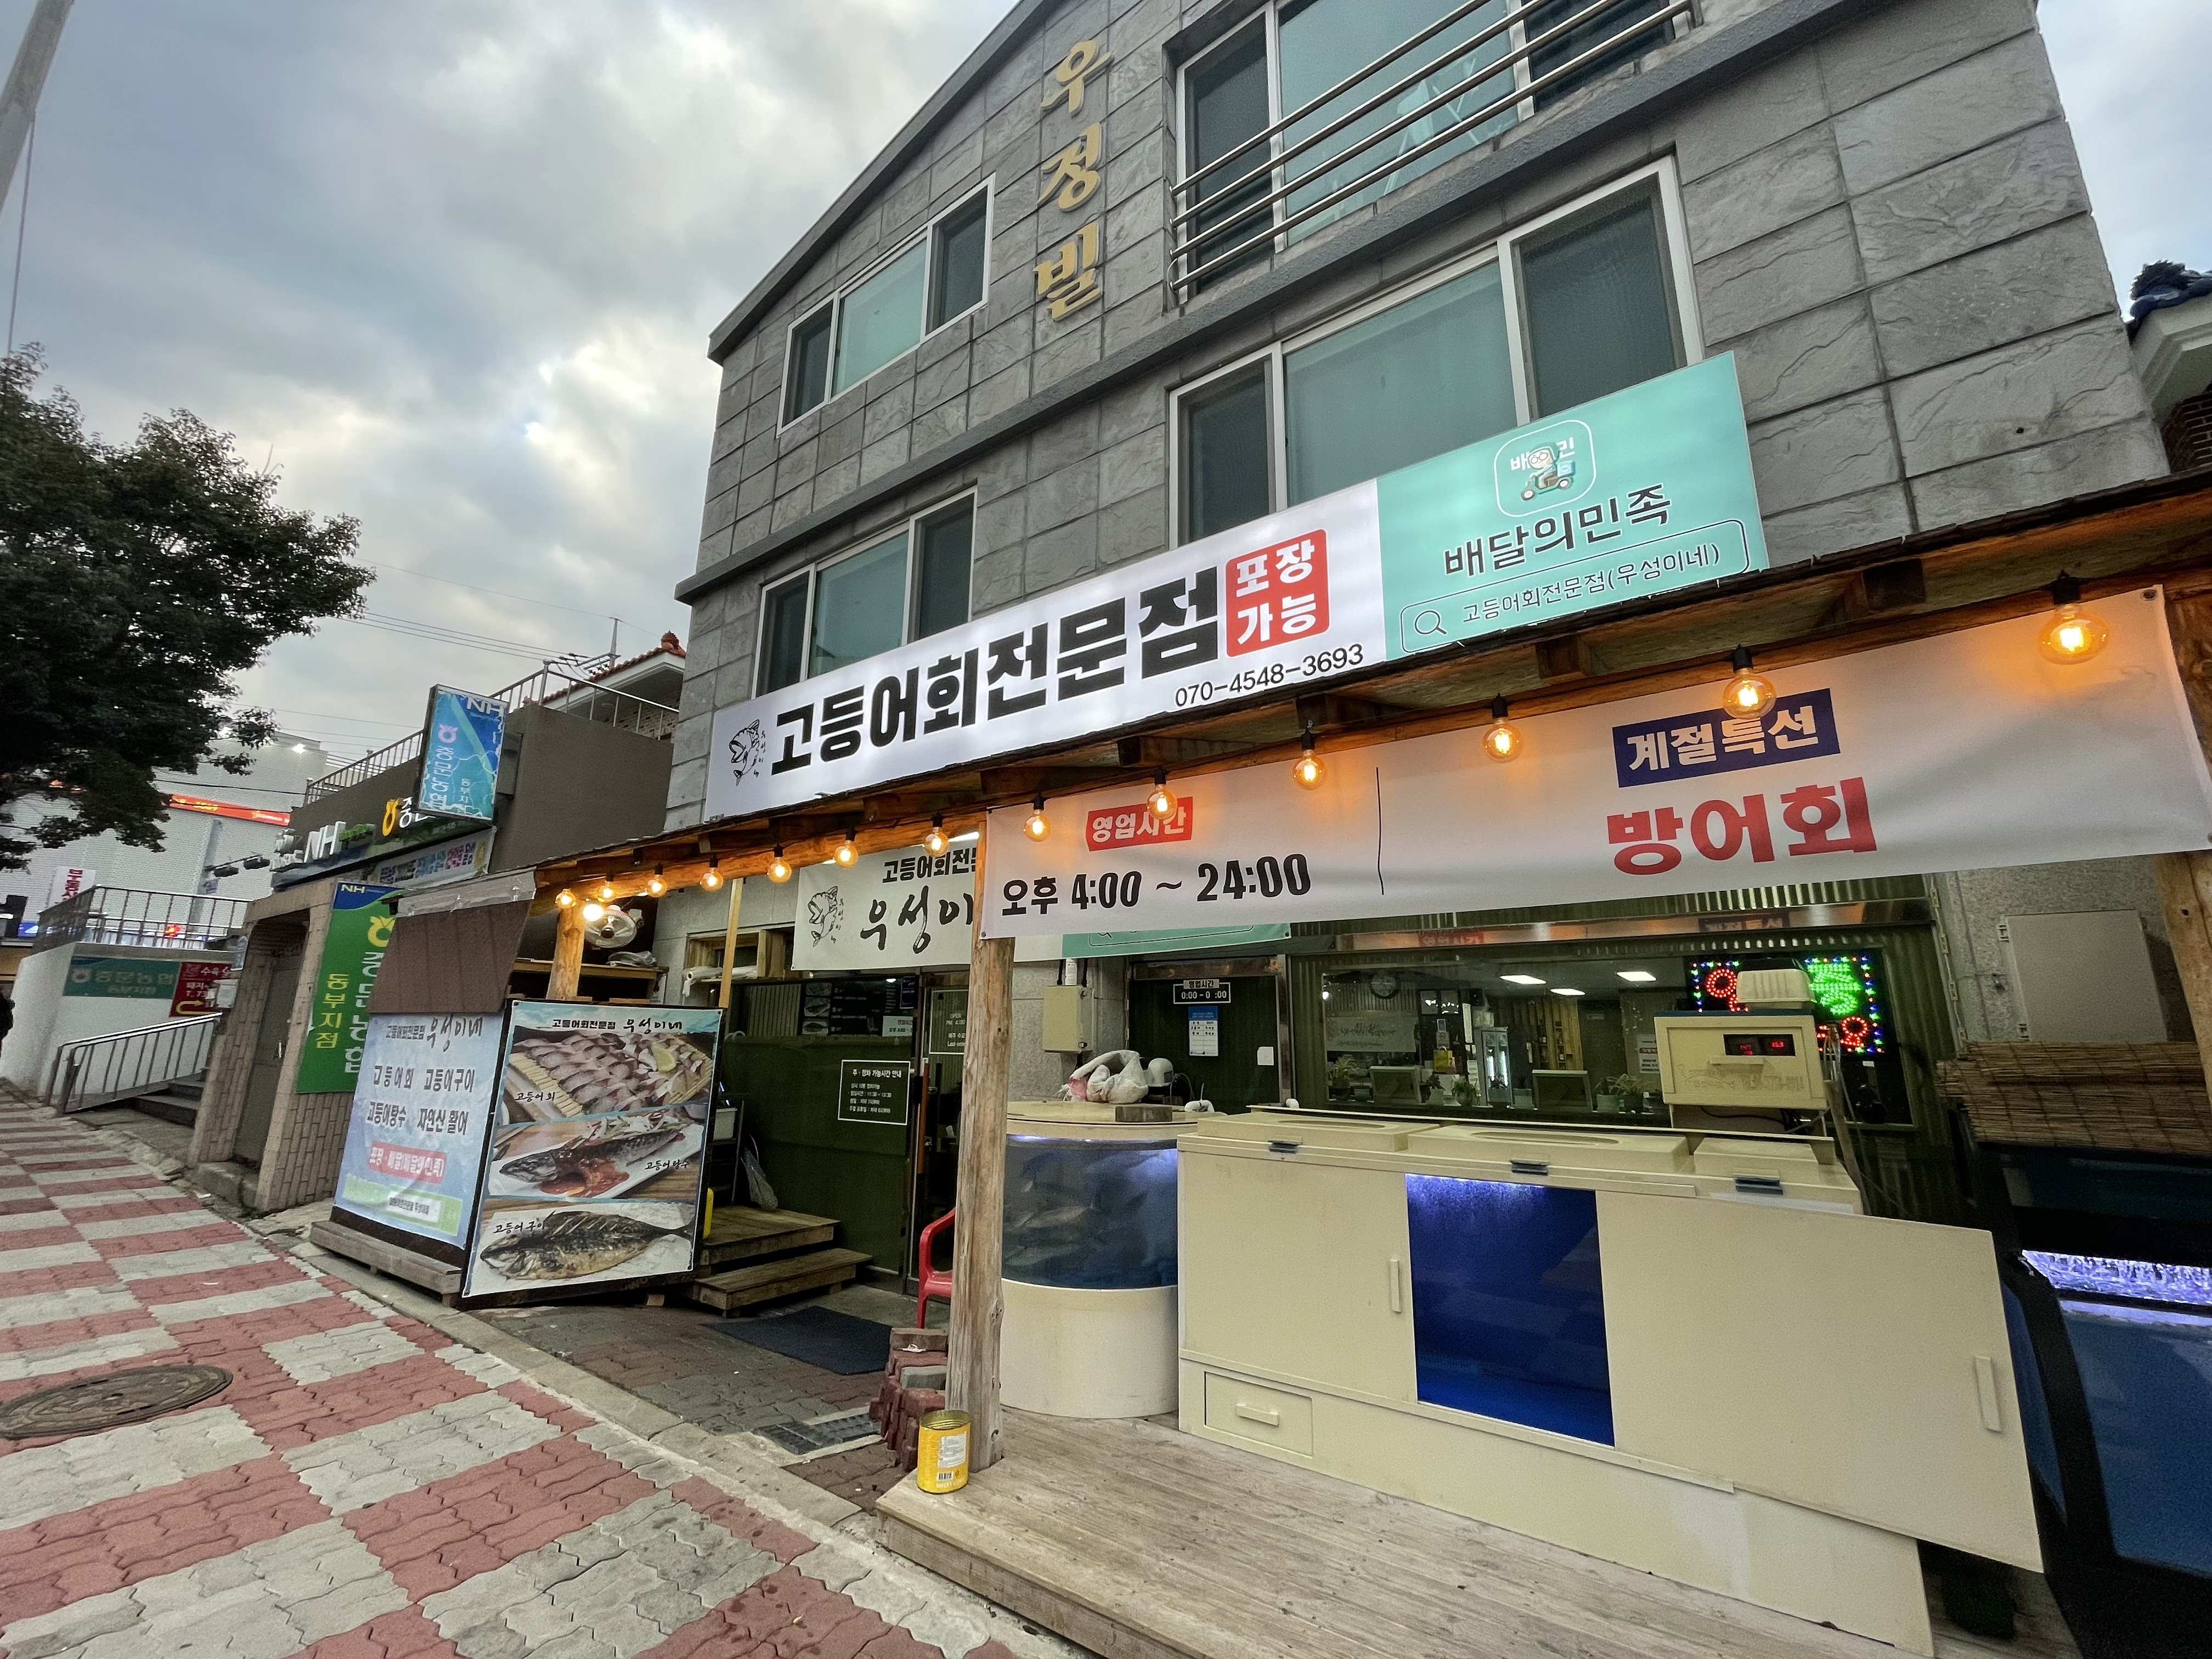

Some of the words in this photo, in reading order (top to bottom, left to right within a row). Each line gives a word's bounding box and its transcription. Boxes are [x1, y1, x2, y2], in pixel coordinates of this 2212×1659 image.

[1034, 40, 1113, 321] 우정빌
[1444, 483, 1672, 577] 배달의민족
[1236, 539, 1315, 597] 포장
[1462, 543, 1720, 623] 고등어회전문점(우성이네)
[1237, 593, 1316, 645] 가능
[771, 566, 1218, 776] 고등어회전문점
[1175, 644, 1364, 707] 070-4548-3693
[466, 697, 504, 717] NH
[1627, 705, 1819, 771] 계절특선
[304, 821, 346, 863] NH
[1092, 805, 1187, 843] 영업시간
[1607, 777, 1877, 876] 방어회
[340, 883, 365, 894] NH
[1002, 876, 1058, 916] 오후
[1071, 870, 1142, 910] 4:00
[1196, 853, 1312, 902] 24:00
[1181, 991, 1197, 1000] 0:00
[1188, 980, 1214, 988] 영업시간
[316, 974, 349, 1048] 동부지점
[552, 1019, 616, 1030] 고등어회전문점
[623, 1017, 682, 1035] 우성이네
[427, 1015, 483, 1052] 우성이네
[373, 1065, 415, 1090] 고등어회
[424, 1069, 475, 1093] 고등어구이
[515, 1091, 543, 1102] 고등어
[545, 1091, 556, 1102] 회
[366, 1101, 406, 1127] 고등어탕수
[417, 1108, 447, 1133] 자연산
[447, 1110, 469, 1135] 활어
[645, 1161, 671, 1171] 고등어
[493, 1222, 523, 1234] 고등어
[525, 1221, 546, 1231] 구이
